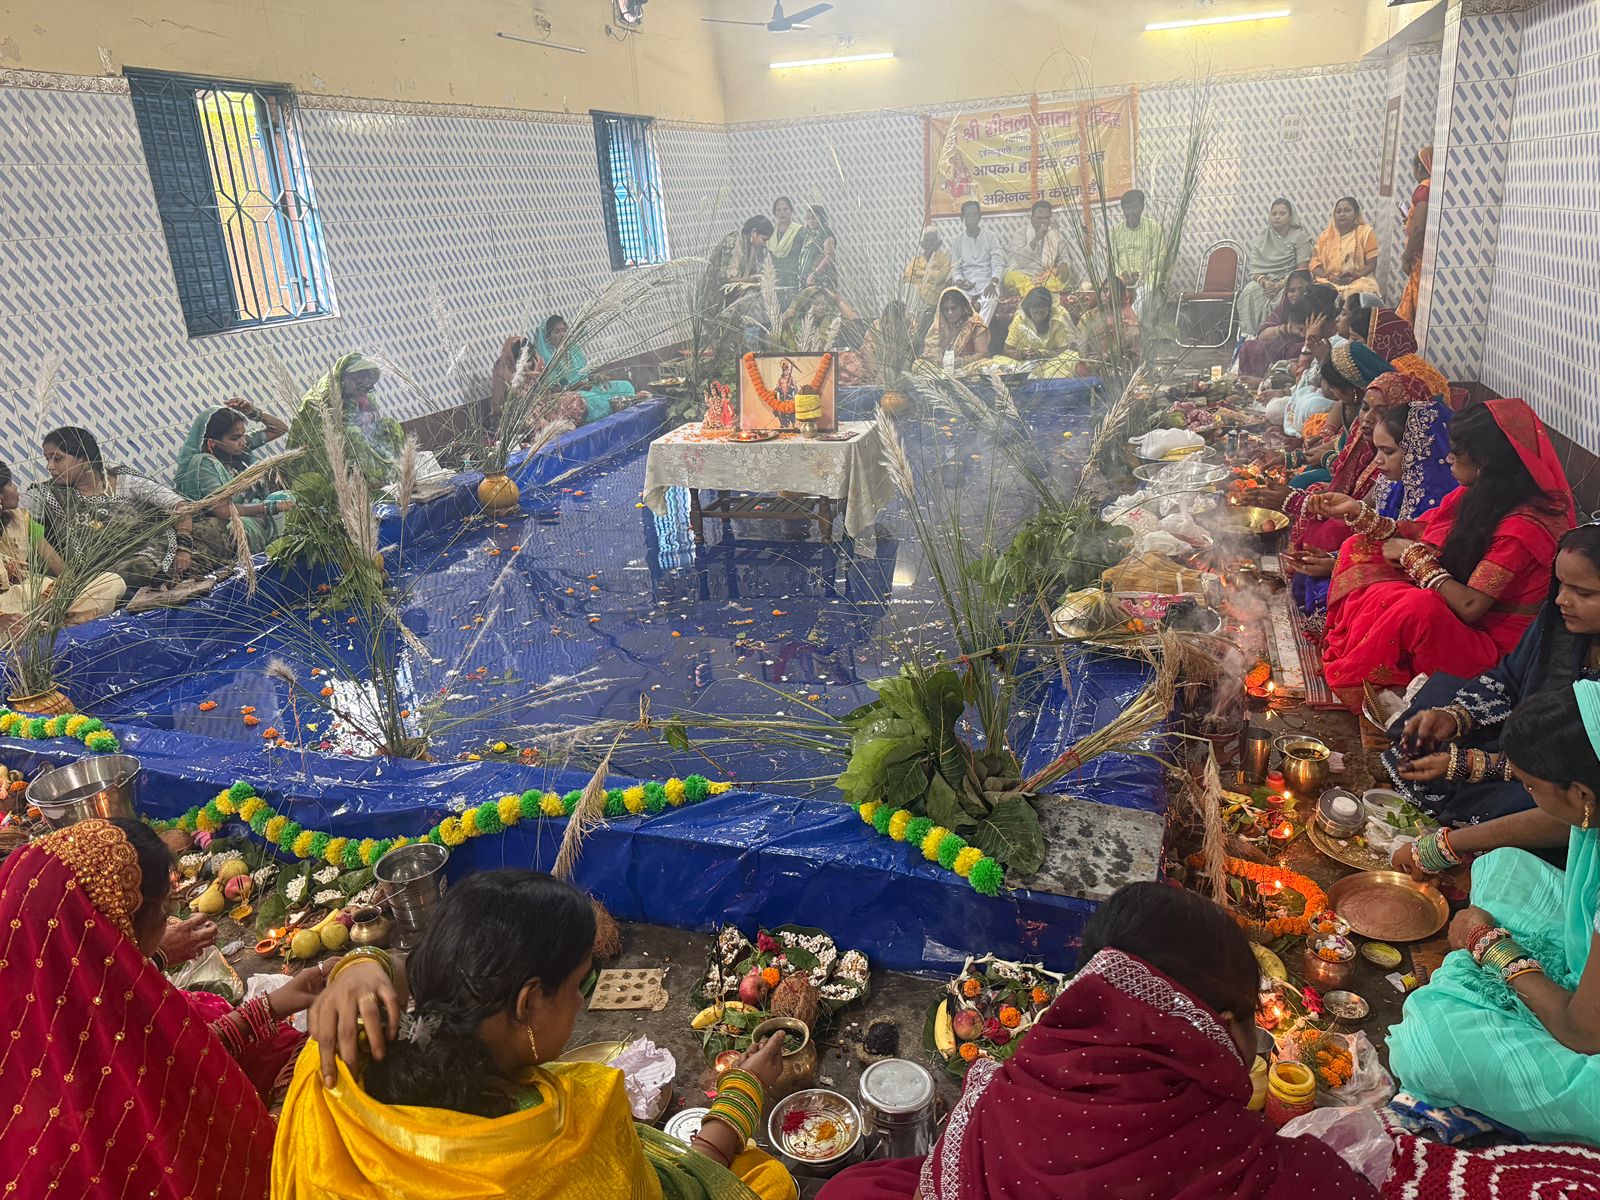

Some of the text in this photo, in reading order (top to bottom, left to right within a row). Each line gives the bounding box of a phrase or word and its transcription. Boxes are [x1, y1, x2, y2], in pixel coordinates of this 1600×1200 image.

[1035, 111, 1072, 128] माता
[973, 163, 1015, 177] आपका
[1063, 151, 1105, 168] स्वगत
